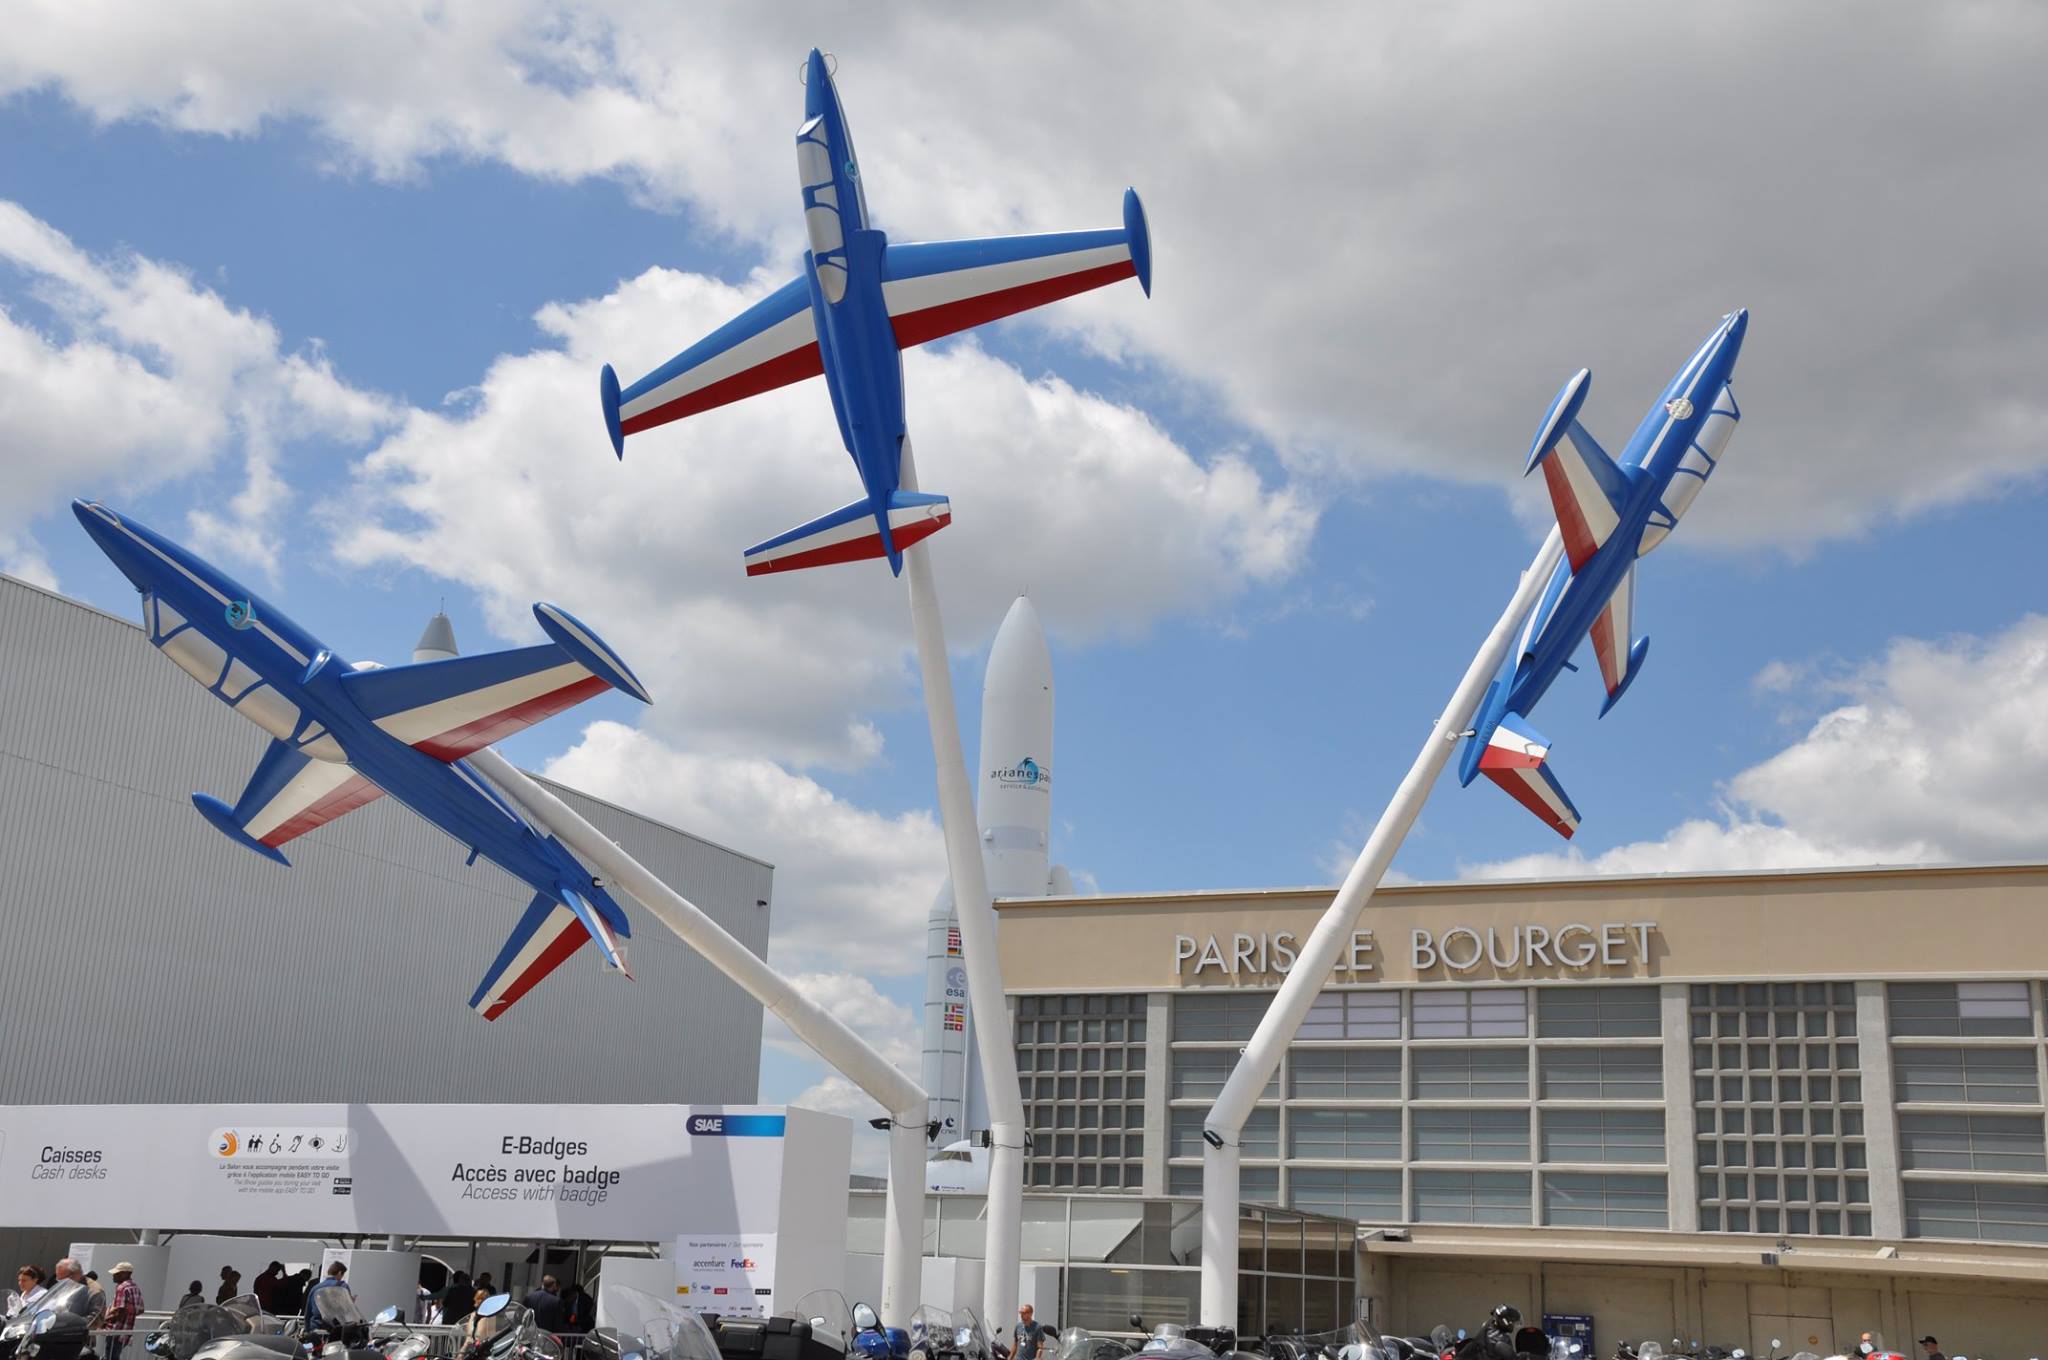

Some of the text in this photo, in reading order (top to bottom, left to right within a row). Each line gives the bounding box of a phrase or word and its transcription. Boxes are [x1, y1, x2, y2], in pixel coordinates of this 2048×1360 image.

[1175, 931, 1297, 975] PARIS
[1412, 922, 1657, 970] BOURGET
[946, 988, 965, 998] esa
[694, 1119, 723, 1132] SIAE
[41, 1145, 103, 1163] Caisses
[501, 1136, 588, 1160] E-Badges
[31, 1164, 108, 1180] Cash desks
[451, 1163, 621, 1190] Accès avec badge
[461, 1183, 608, 1207] Access with badge
[693, 1258, 755, 1268] accenture FedEx
